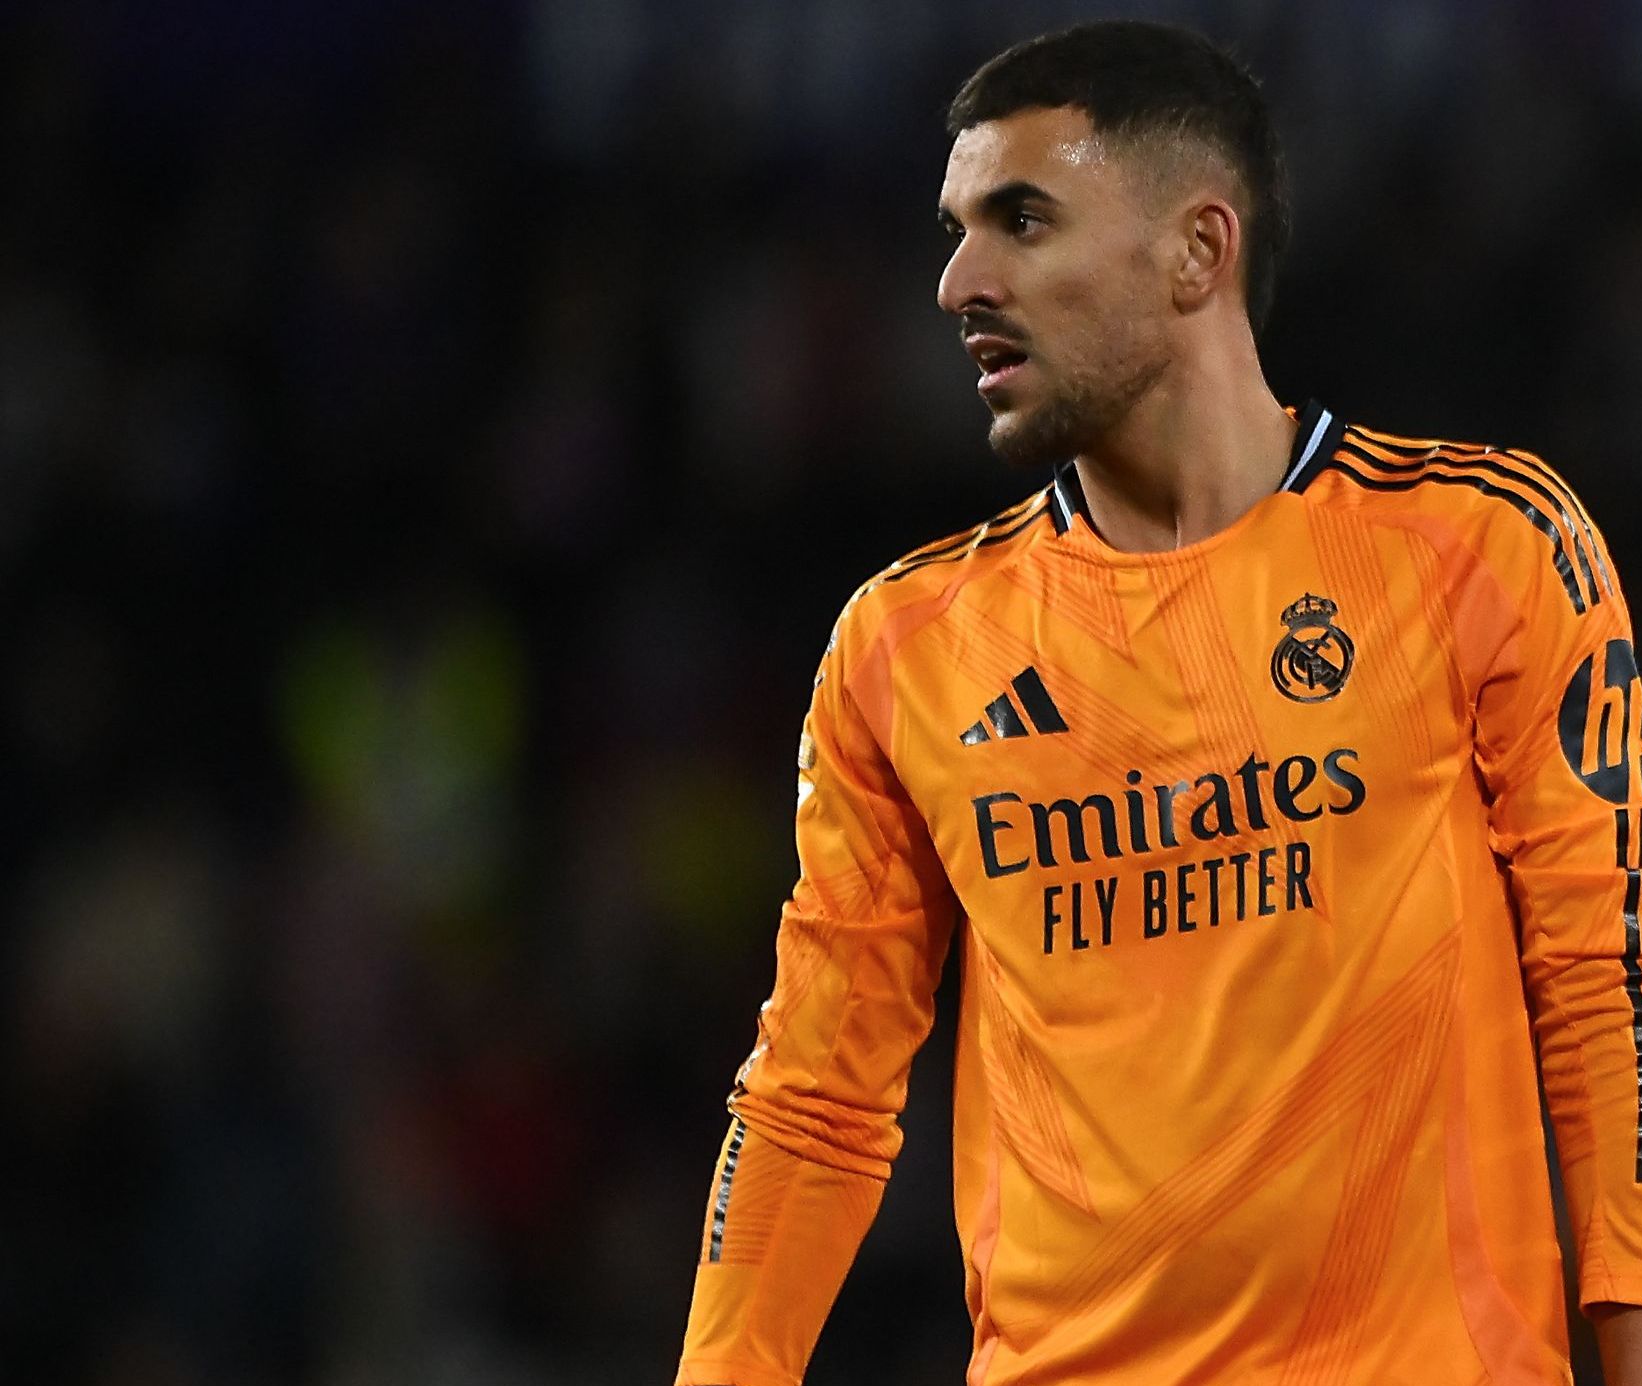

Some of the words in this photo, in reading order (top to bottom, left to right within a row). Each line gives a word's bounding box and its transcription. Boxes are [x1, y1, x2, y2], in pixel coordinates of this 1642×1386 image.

[971, 747, 1368, 880] Emirates
[1043, 876, 1119, 955] FLY
[1142, 841, 1315, 940] BETTER
